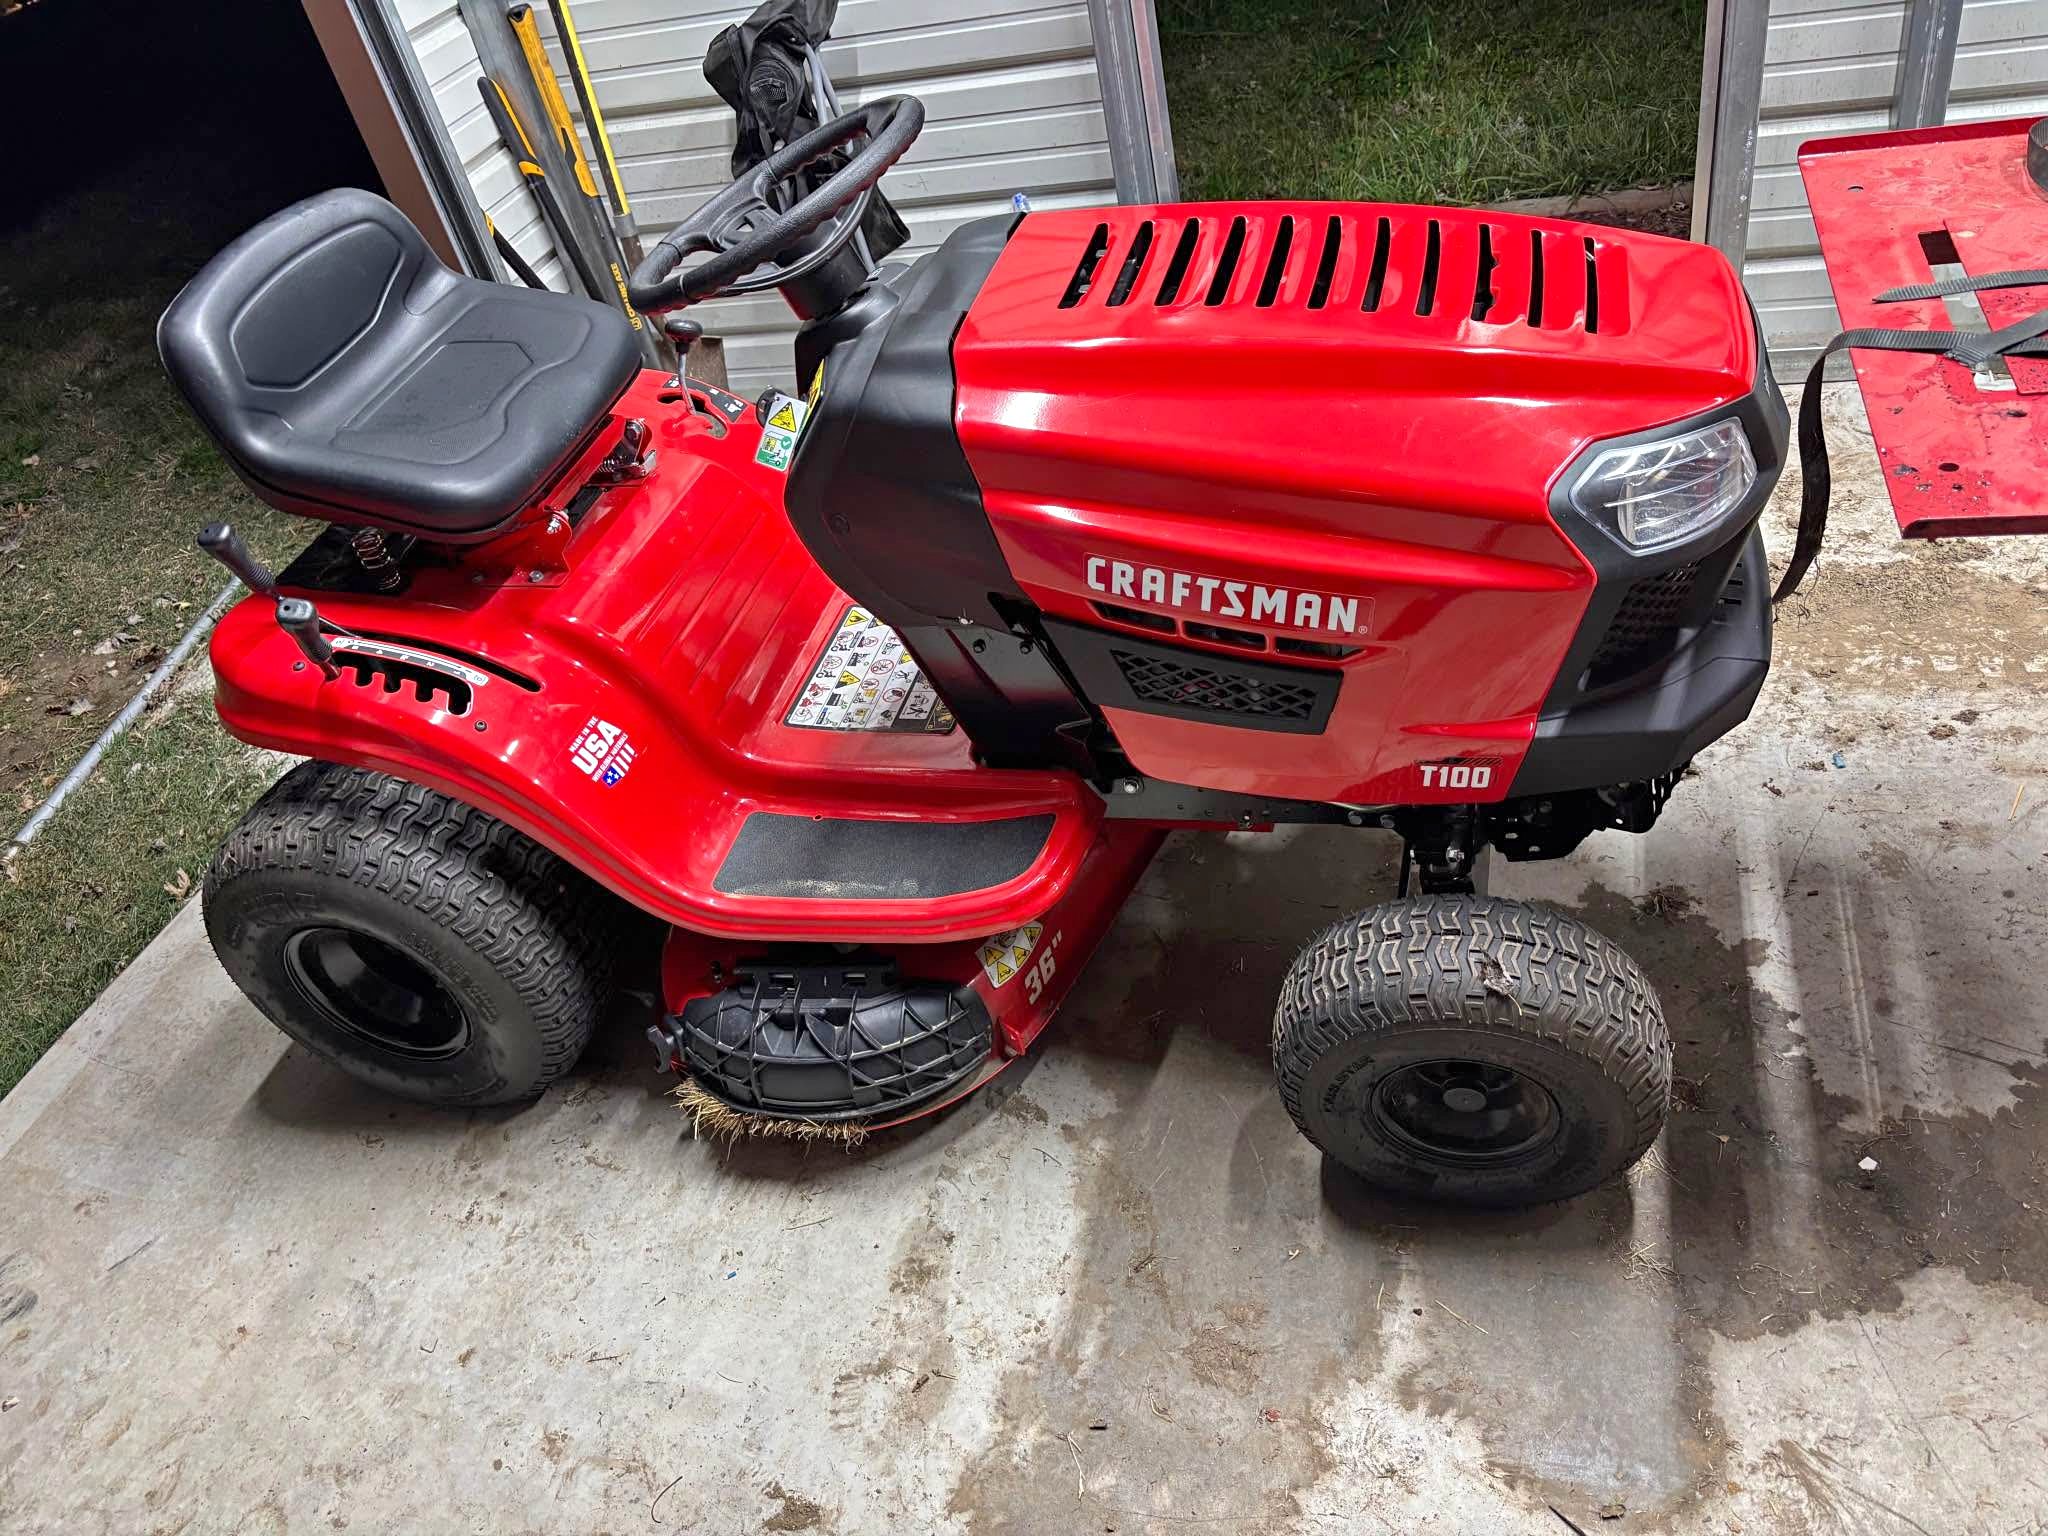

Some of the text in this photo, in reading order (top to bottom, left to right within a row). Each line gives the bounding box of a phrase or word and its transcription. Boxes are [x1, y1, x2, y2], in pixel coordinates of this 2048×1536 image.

[1087, 557, 1358, 633] CRAFTSMAN
[568, 716, 599, 753] MADE IN THE
[571, 720, 622, 775] USA
[1420, 765, 1491, 788] T100
